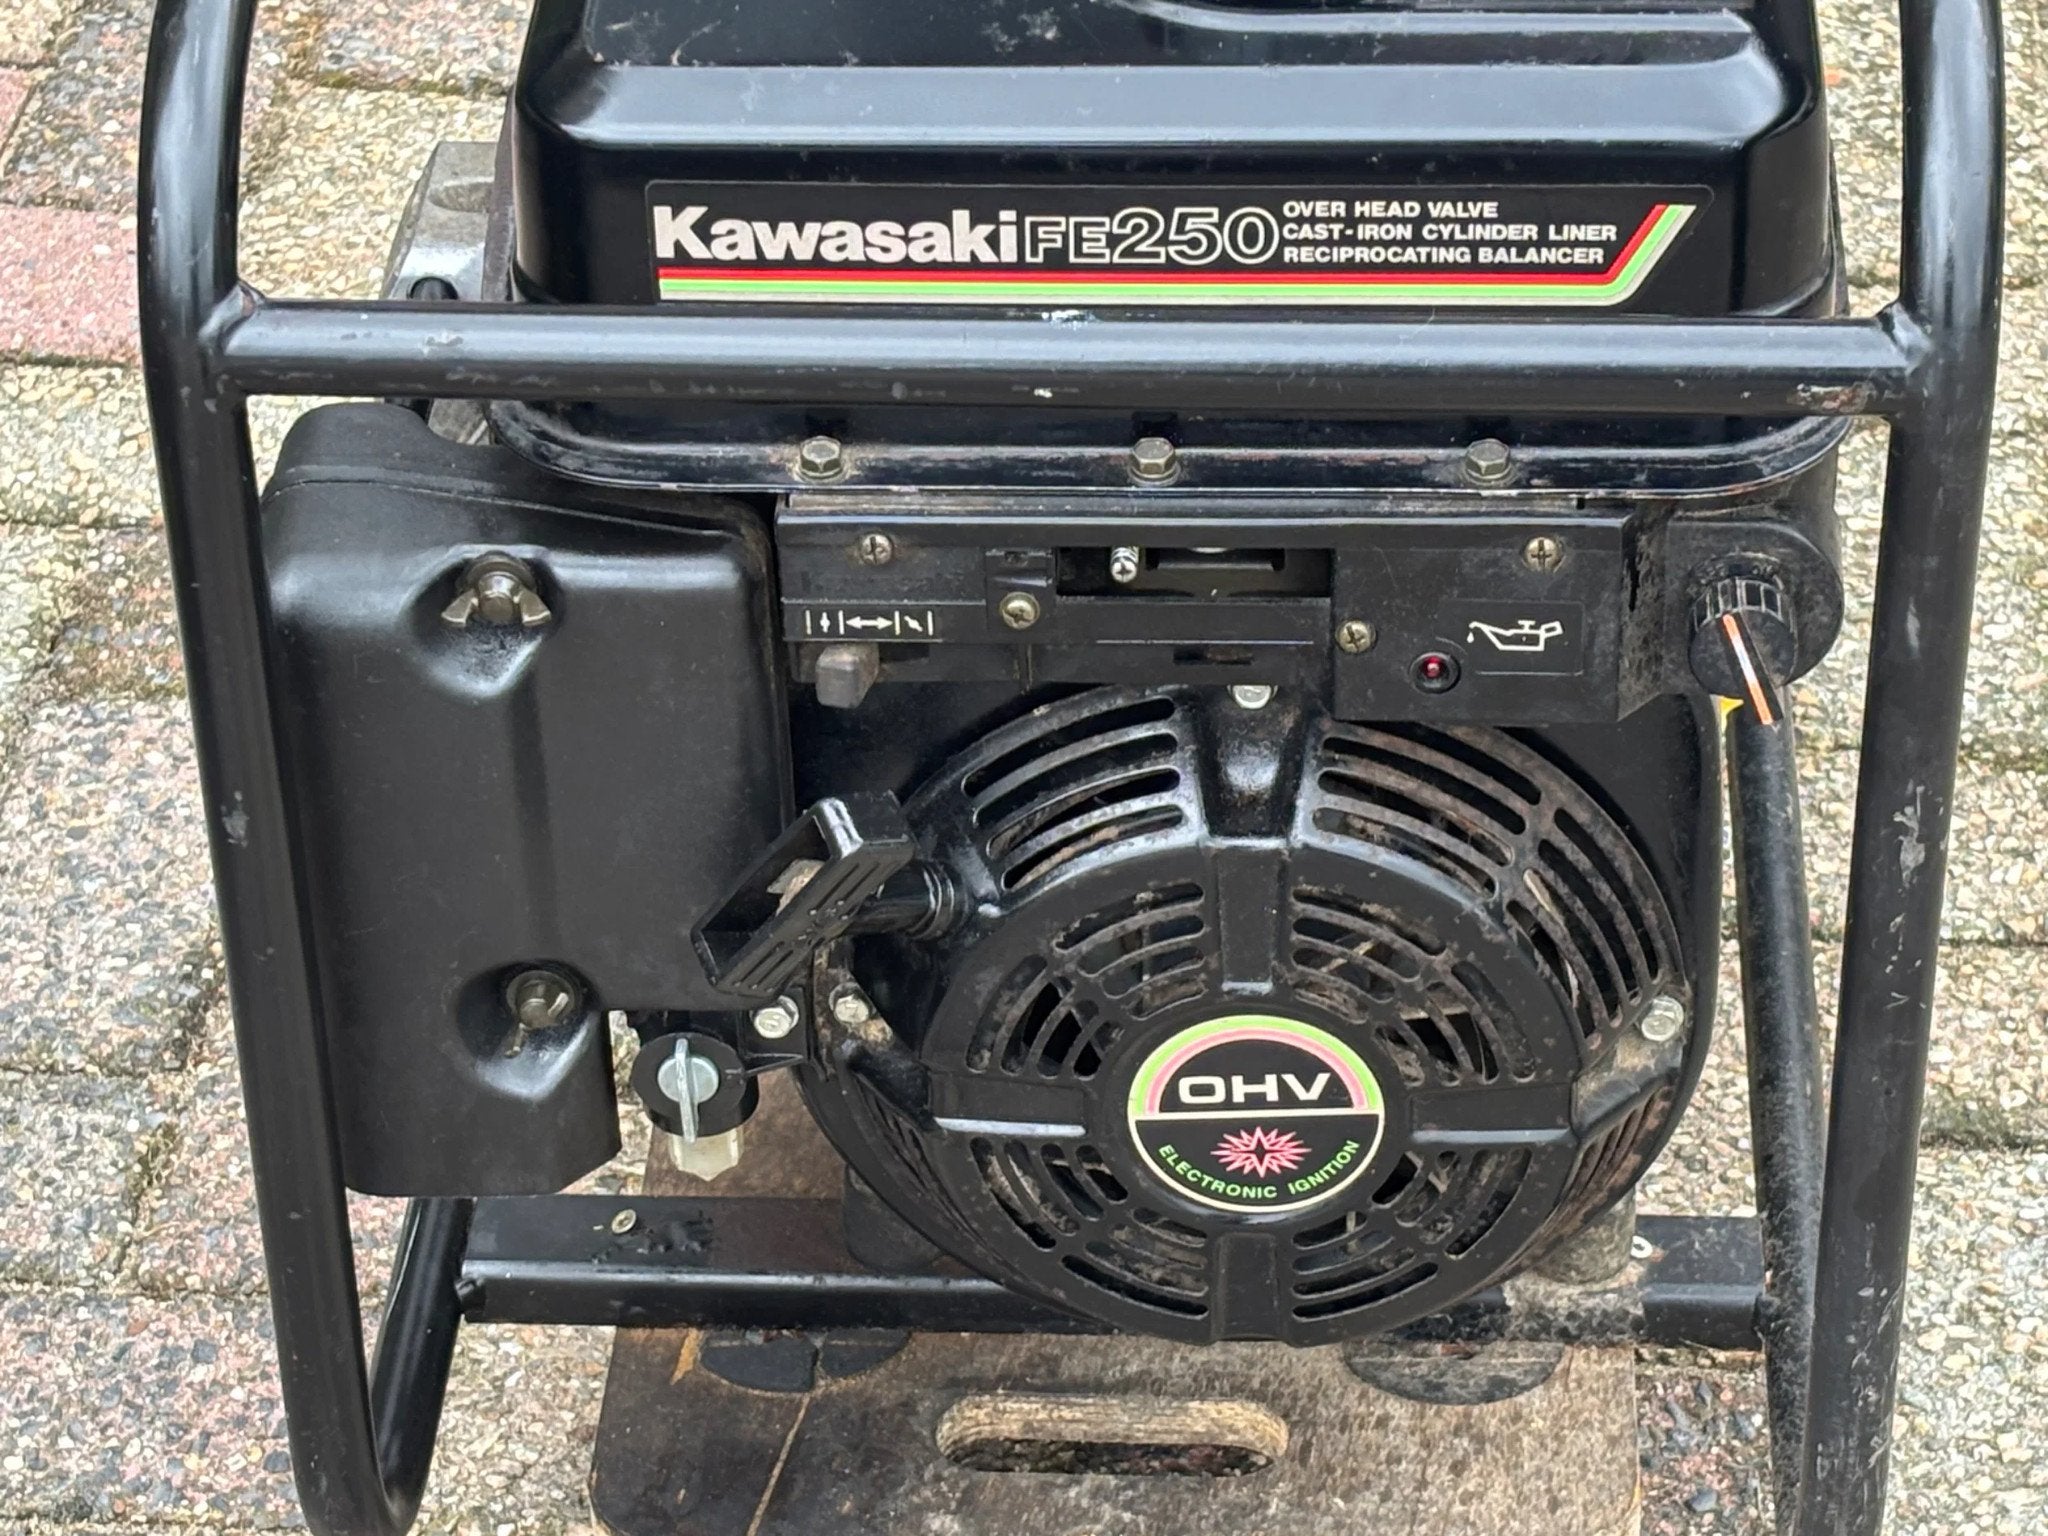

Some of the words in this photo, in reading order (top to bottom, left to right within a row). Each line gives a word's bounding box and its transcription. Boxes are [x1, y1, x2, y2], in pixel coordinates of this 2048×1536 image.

[1283, 201, 1346, 218] OVER
[1354, 201, 1421, 218] HEAD
[1427, 202, 1499, 219] VALVE
[652, 206, 1018, 264] Kawasaki
[1024, 207, 1280, 265] FE250
[1422, 224, 1538, 242] CYLINDER
[1549, 224, 1617, 242] LINER
[1283, 247, 1472, 265] RECIPROCATING
[1478, 247, 1605, 265] BALANCER
[1178, 1072, 1331, 1104] OHV
[1158, 1144, 1278, 1199] ELECTRONIC
[1288, 1139, 1361, 1195] IGNITION
